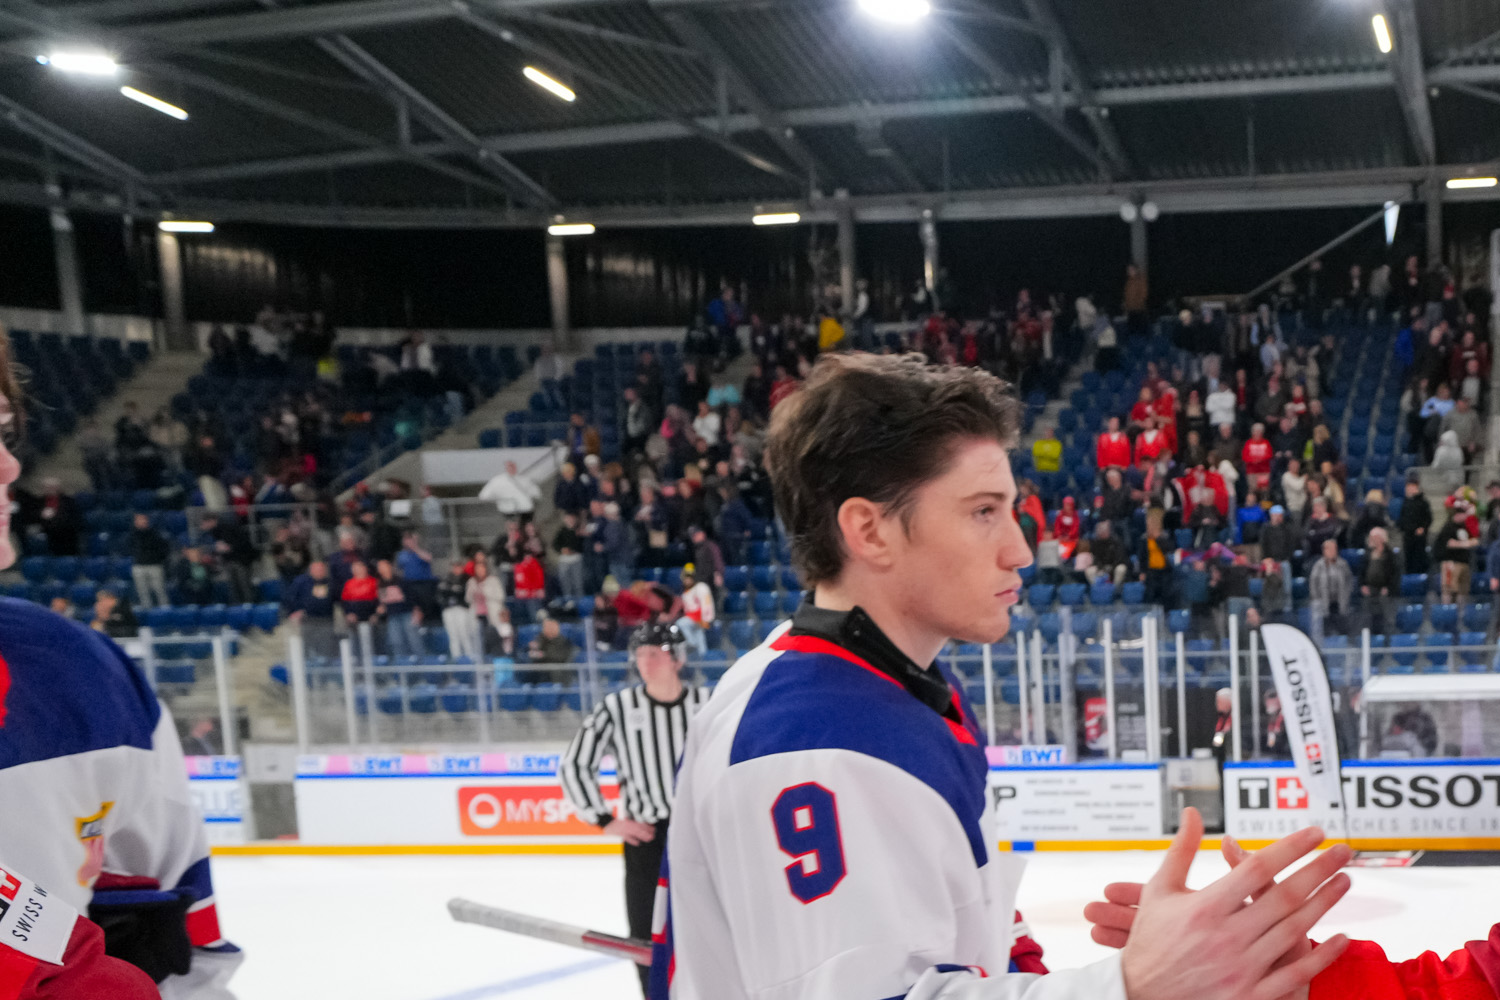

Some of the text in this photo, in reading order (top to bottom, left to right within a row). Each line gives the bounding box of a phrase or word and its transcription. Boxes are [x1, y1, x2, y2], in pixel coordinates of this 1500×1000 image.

[1282, 655, 1316, 743] TISSOT
[1022, 749, 1062, 763] BWT
[770, 781, 848, 905] 9
[12, 898, 43, 942] SWISS
